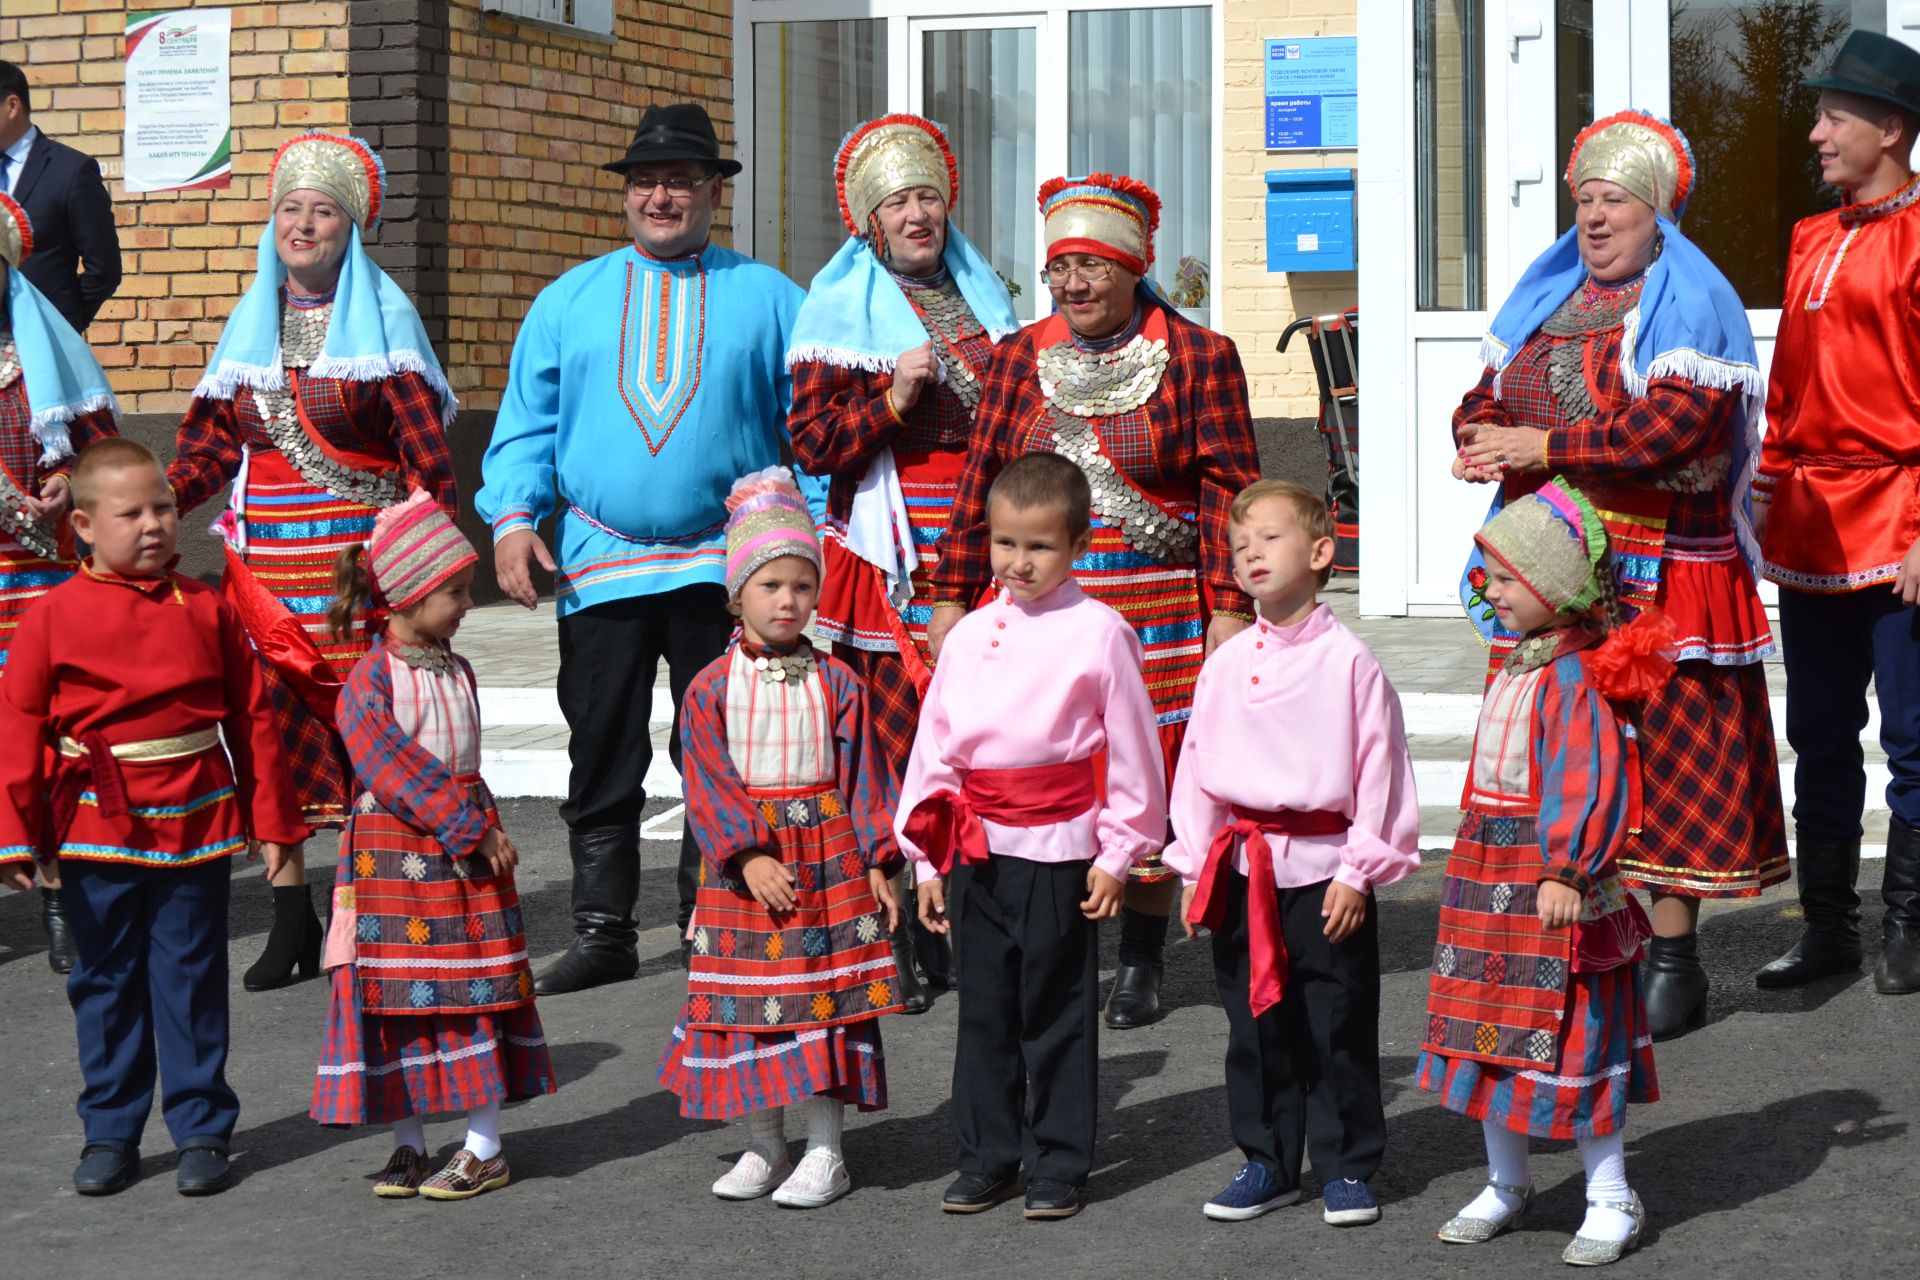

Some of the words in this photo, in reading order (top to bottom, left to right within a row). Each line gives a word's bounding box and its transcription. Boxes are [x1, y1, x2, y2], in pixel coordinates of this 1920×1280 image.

[159, 31, 165, 44] 8
[1289, 99, 1312, 107] работы
[1271, 212, 1345, 235] ПОЧТА
